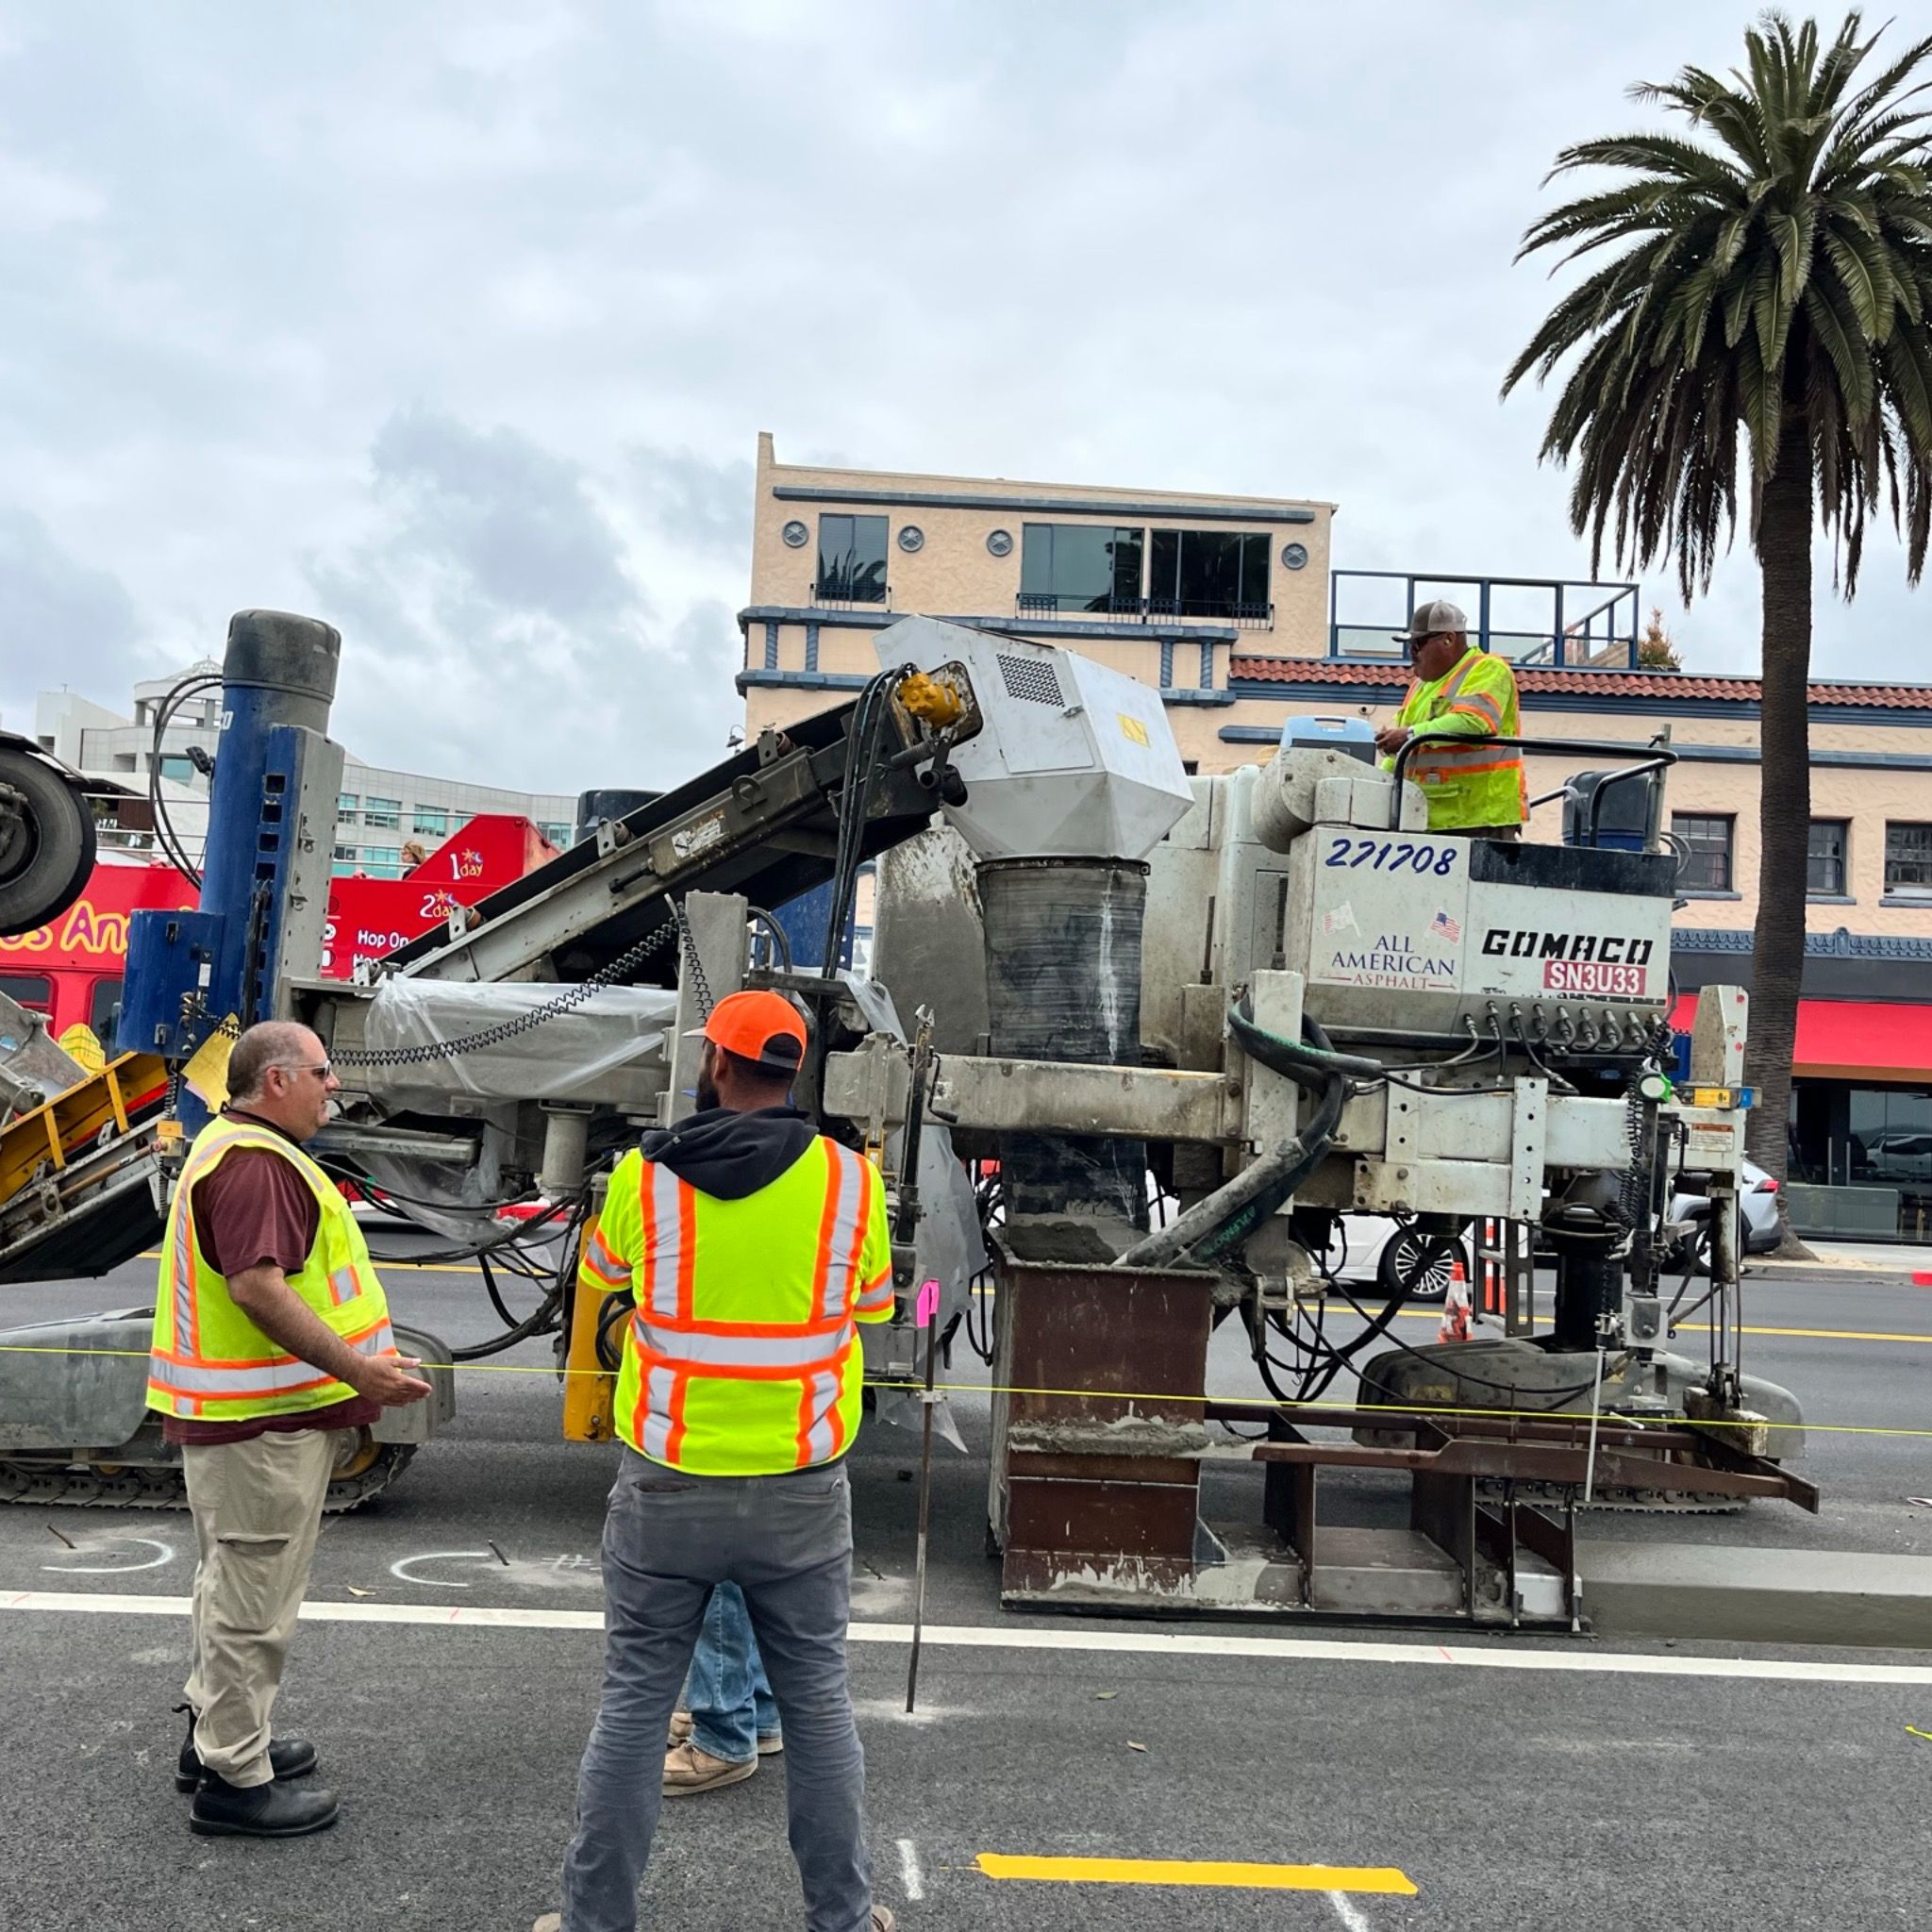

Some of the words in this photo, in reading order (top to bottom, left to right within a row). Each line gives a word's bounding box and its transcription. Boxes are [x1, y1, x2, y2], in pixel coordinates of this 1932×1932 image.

[1324, 838, 1457, 875] 271708
[358, 928, 386, 949] Hop
[389, 931, 408, 948] On
[1374, 935, 1414, 953] ALL
[1481, 929, 1654, 965] GOMACO
[1331, 951, 1455, 975] AMERICAN
[1353, 973, 1429, 990] ASPHALT
[1549, 961, 1640, 994] SN3U33
